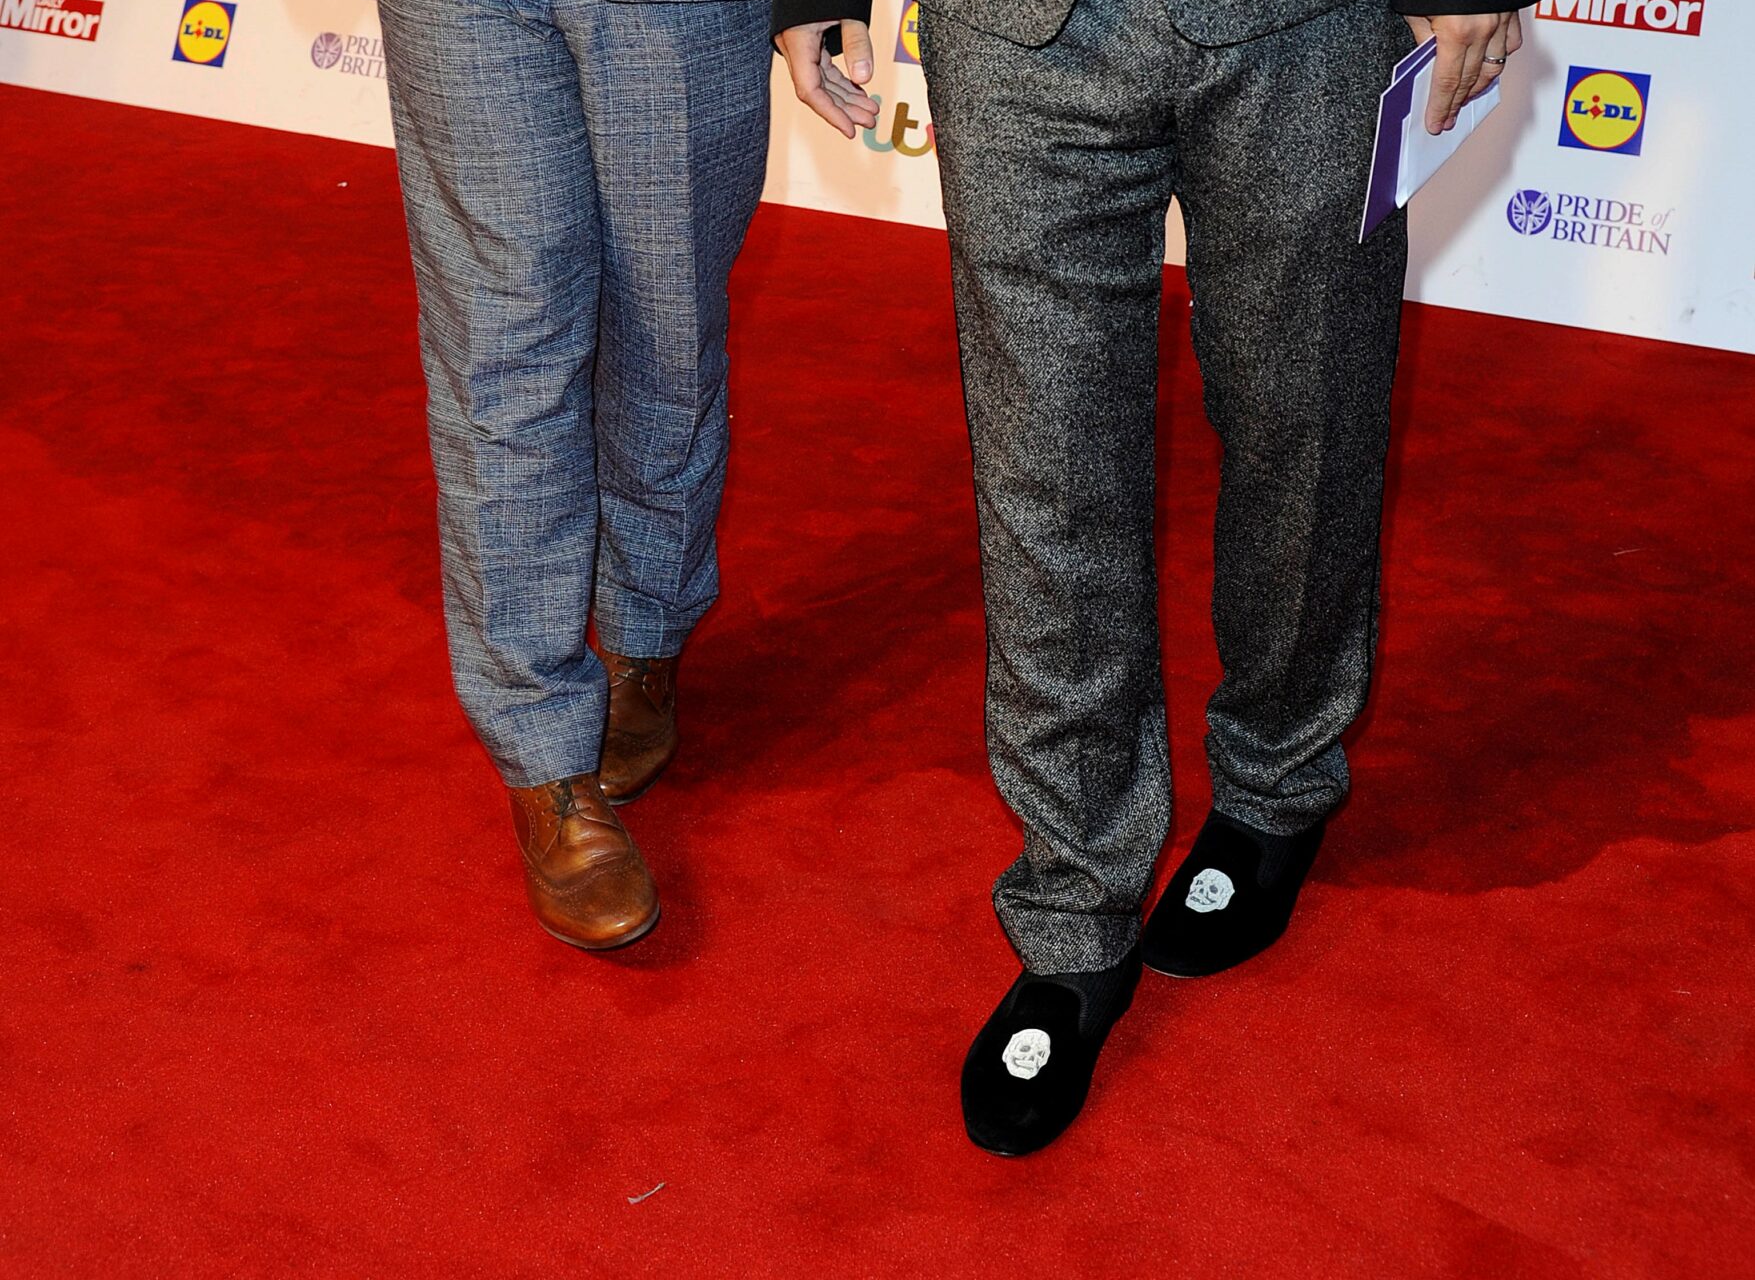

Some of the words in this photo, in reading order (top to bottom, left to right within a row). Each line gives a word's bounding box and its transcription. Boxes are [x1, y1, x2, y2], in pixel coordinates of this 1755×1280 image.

[344, 35, 384, 57] PRI
[339, 55, 387, 79] BRIT
[863, 94, 938, 158] it
[1556, 193, 1644, 226] PRIDE
[1651, 208, 1675, 231] of
[1551, 218, 1672, 255] BRITAIN
